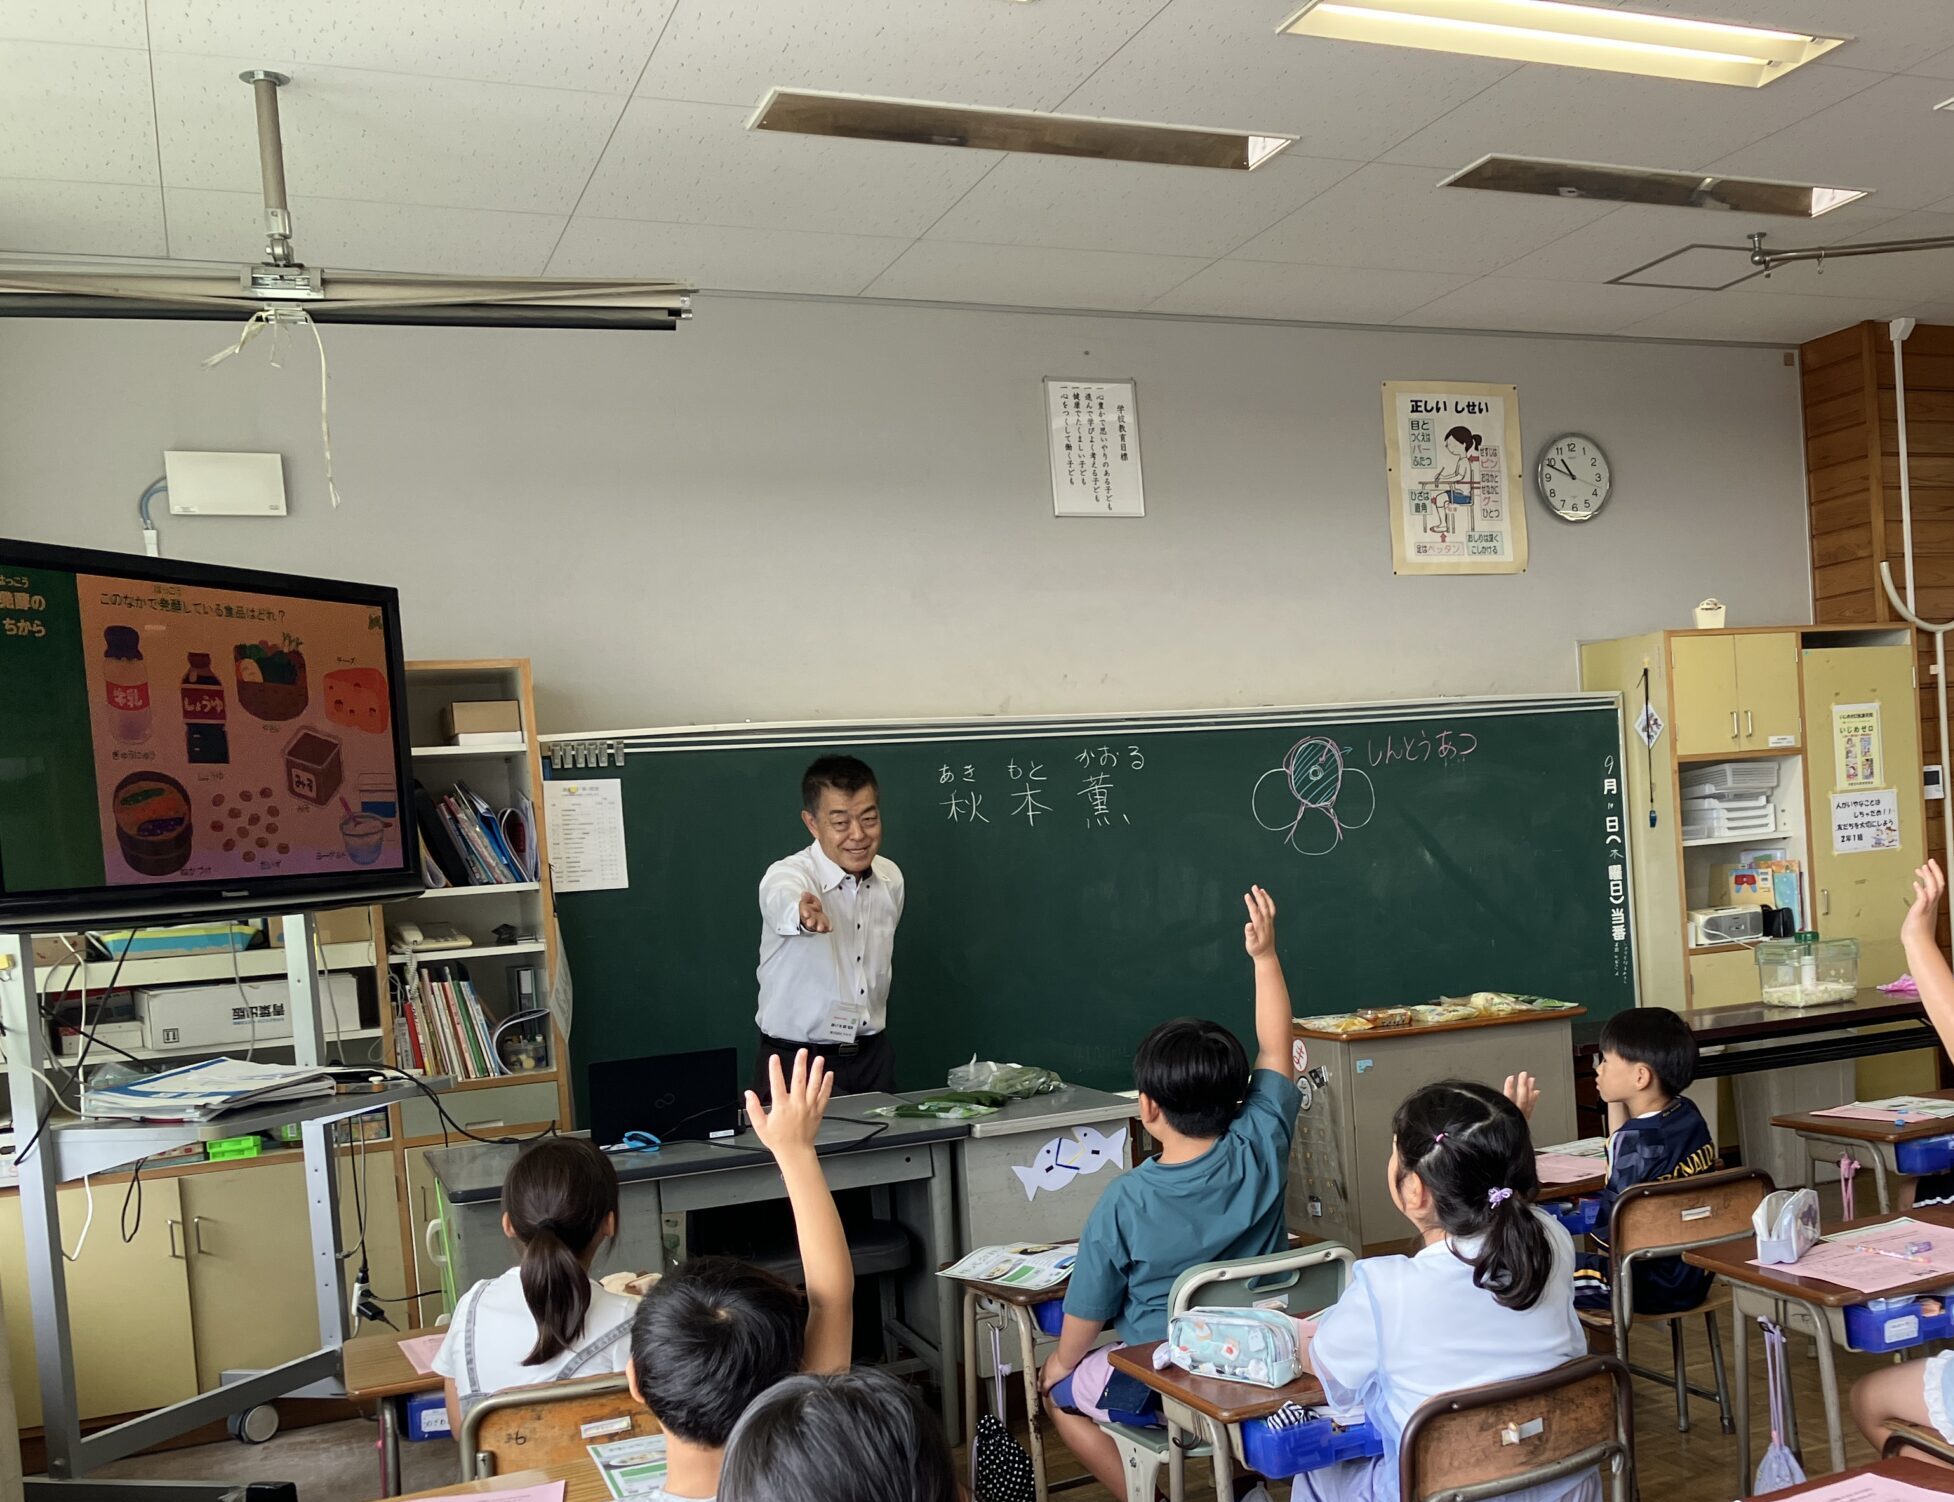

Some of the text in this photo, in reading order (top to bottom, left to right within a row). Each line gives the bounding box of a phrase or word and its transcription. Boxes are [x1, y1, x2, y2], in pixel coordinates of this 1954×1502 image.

[1410, 400, 1489, 414] 正しい しせい
[1410, 420, 1430, 431] 目と
[1117, 405, 1128, 461] 学校教育目標
[1410, 433, 1431, 443] つくえは
[1556, 447, 1563, 456] 11
[1567, 443, 1576, 452] 12
[1583, 446, 1586, 456] 1
[1412, 457, 1432, 467] ふたつ
[1547, 457, 1556, 467] 10
[1591, 457, 1597, 467] 2
[1545, 473, 1552, 482] 9
[1595, 473, 1601, 482] 3
[1411, 490, 1430, 501] ひざは
[1550, 488, 1556, 498] 8
[1592, 489, 1598, 497] 4
[1560, 499, 1566, 508] 7
[1571, 503, 1578, 512] 6
[1584, 499, 1590, 508] 5
[1483, 508, 1500, 519] ひとつ
[3, 618, 46, 637] ちから
[113, 688, 142, 708] 牛乳
[184, 696, 223, 713] しょうゆ
[1840, 725, 1873, 734] いじめゼロ
[1074, 745, 1146, 770] かおる
